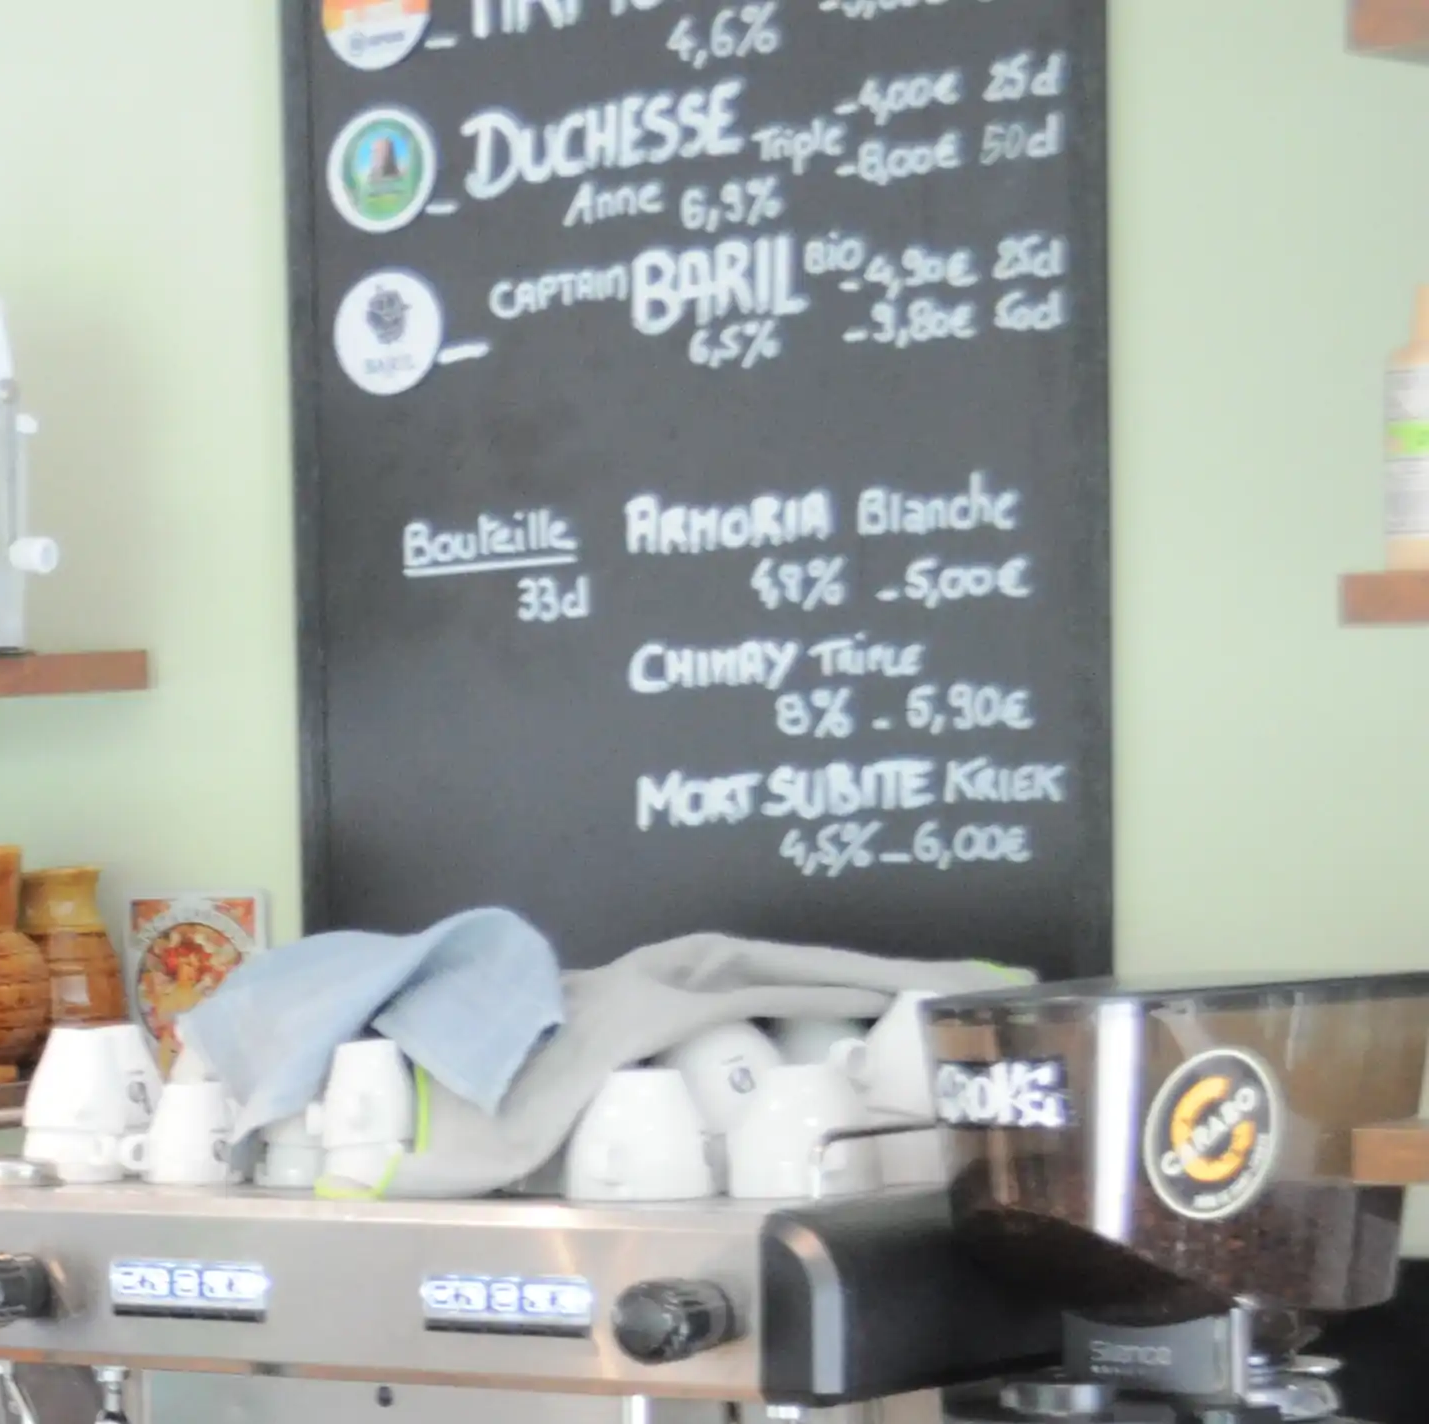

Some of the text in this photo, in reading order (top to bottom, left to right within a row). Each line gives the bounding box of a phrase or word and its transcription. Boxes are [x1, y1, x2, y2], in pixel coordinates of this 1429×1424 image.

[461, 79, 745, 199] DUCHESSE
[563, 181, 665, 227] Anne
[632, 235, 809, 335] BARIL
[857, 471, 1023, 538] Blanche
[403, 508, 579, 567] Bouteille
[628, 639, 799, 693] CHIMAY
[774, 685, 854, 739] 8%
[637, 770, 758, 830] MORT
[762, 760, 936, 820] SUBITE
